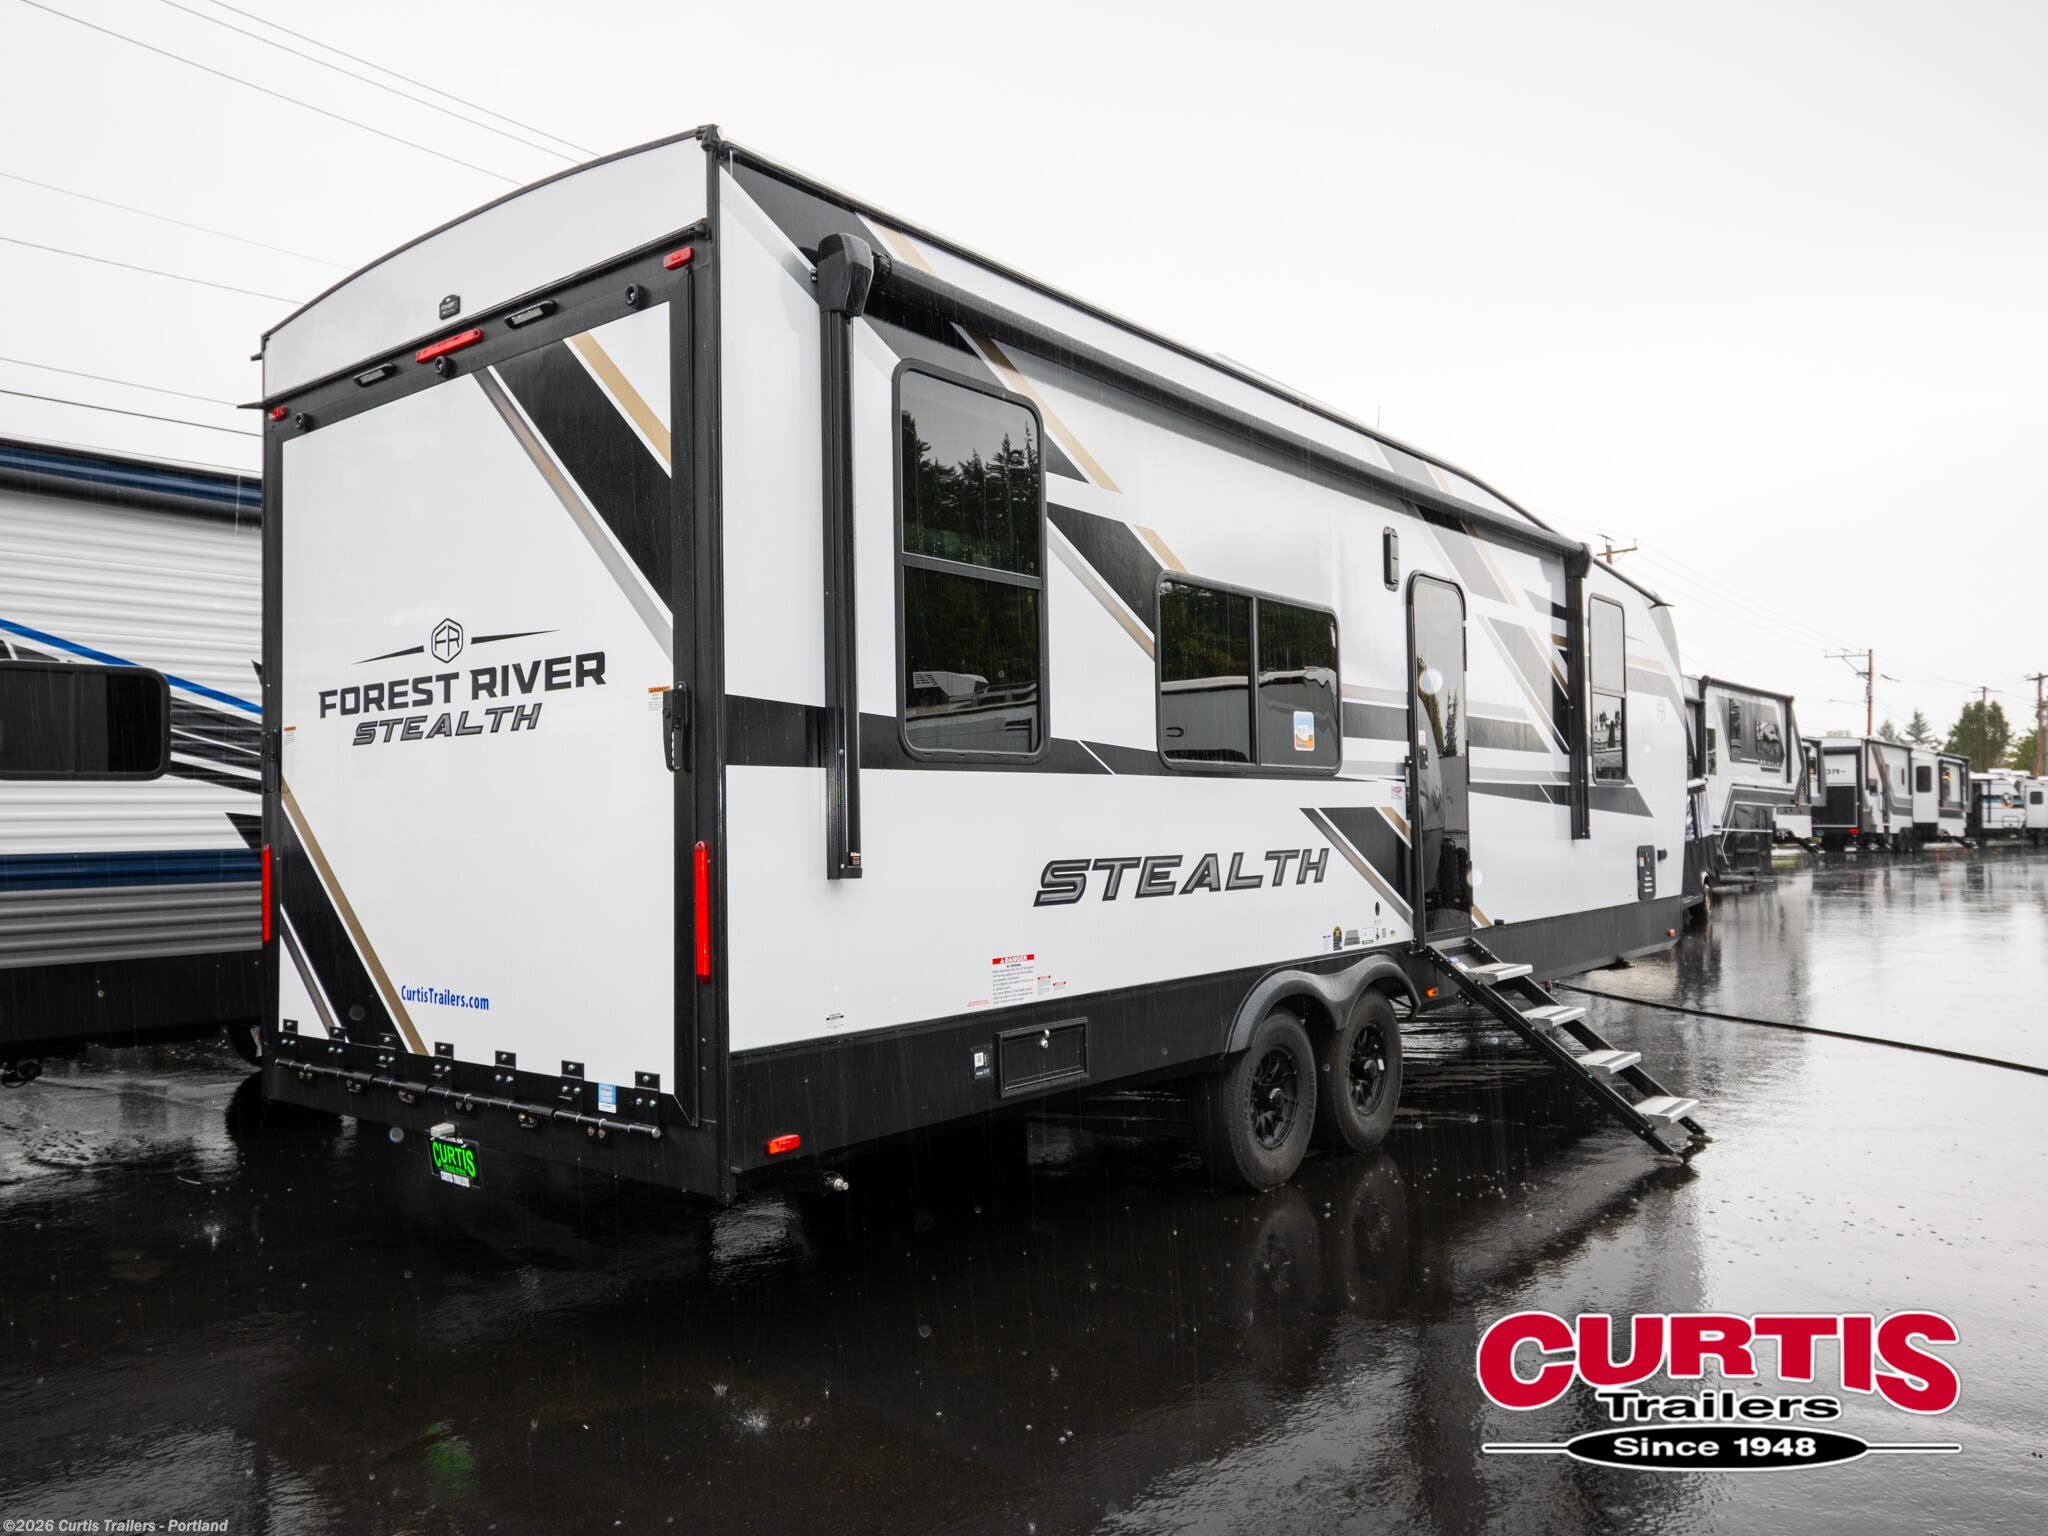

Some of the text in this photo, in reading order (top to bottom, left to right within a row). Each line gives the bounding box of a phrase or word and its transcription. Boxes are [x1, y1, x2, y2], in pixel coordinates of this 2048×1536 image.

[318, 671, 460, 719] FOREST
[469, 651, 607, 701] RIVER
[352, 702, 543, 746] STEALTH
[1033, 847, 1330, 907] STEALTH
[1004, 954, 1028, 964] DANGER
[401, 984, 489, 1010] CurtisTrailers.com
[432, 1141, 476, 1178] CURTIS
